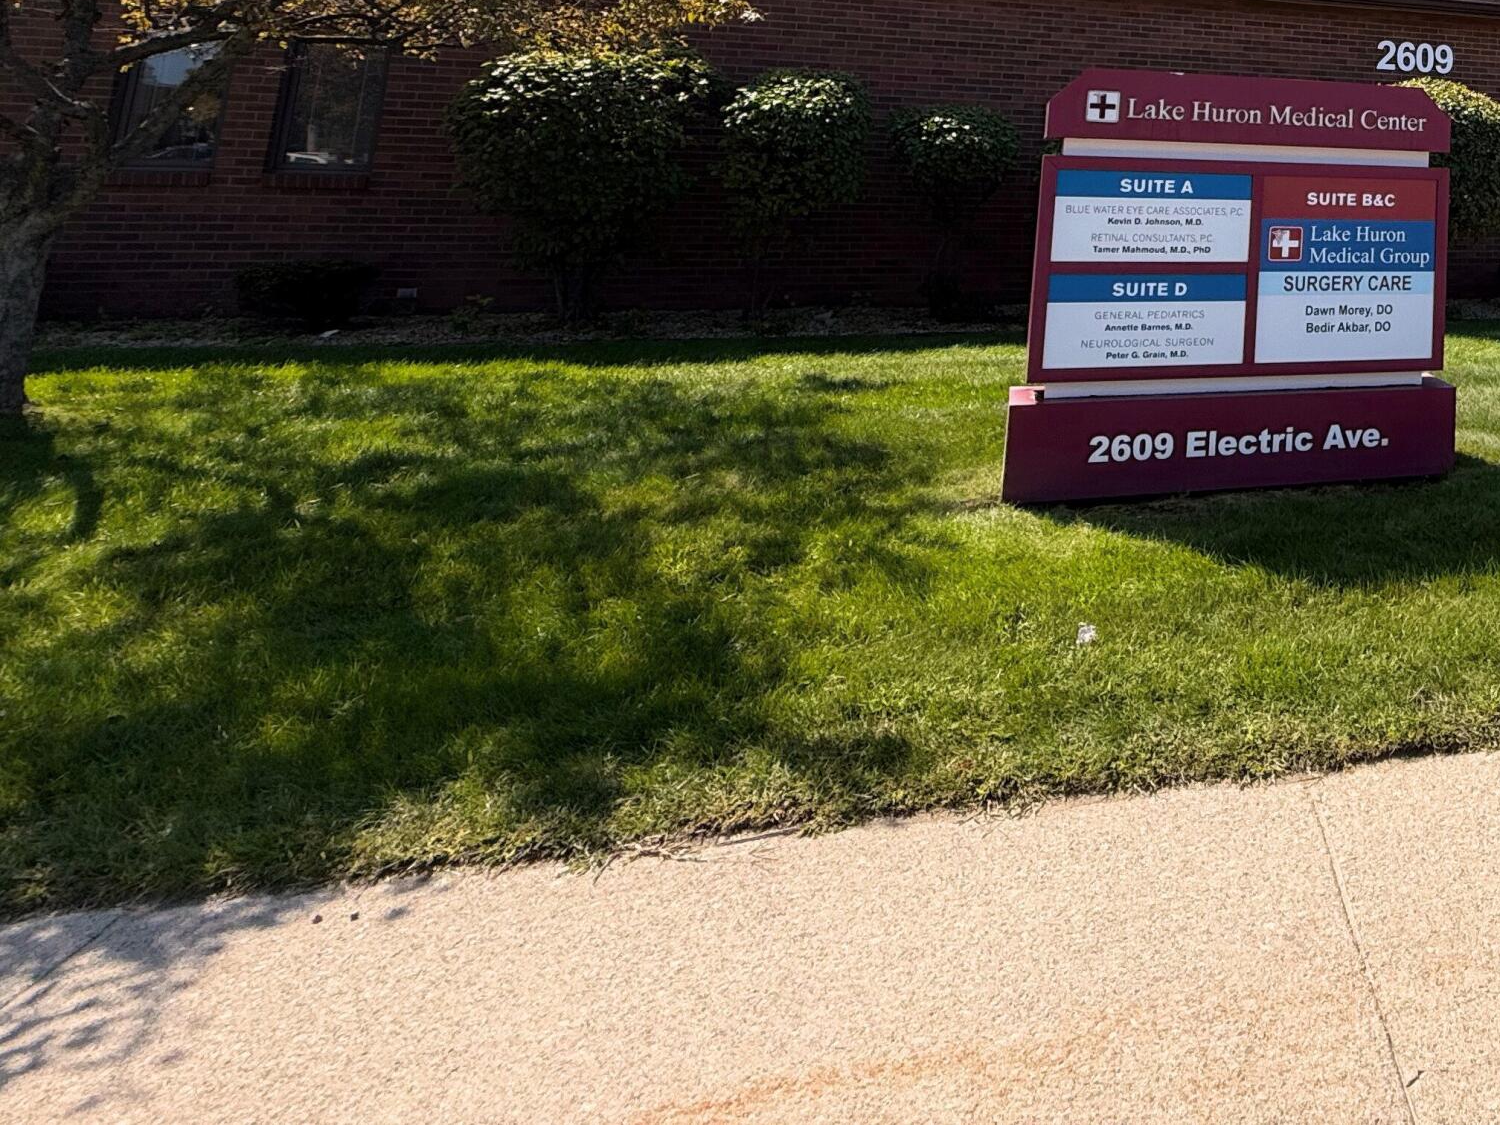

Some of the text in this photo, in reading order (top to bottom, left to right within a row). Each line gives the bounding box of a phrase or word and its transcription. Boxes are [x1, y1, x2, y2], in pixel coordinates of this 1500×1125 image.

[1376, 41, 1453, 73] 2609
[1128, 98, 1426, 132] Lake Huron Medical Center
[1120, 179, 1193, 194] SUITE A
[1307, 193, 1396, 206] SUITE B&C
[1065, 205, 1090, 214] BLUE
[1094, 206, 1123, 214] WATER
[1126, 206, 1143, 214] EYE
[1147, 206, 1169, 215] CARE
[1173, 207, 1227, 216] ASSOCIATES,
[1145, 218, 1182, 226] Johnson,
[1091, 234, 1129, 242] RETINAL
[1132, 234, 1197, 243] CONSULTANTS,
[1311, 226, 1406, 242] Lake Huron
[1122, 246, 1167, 254] Mahmoud,
[1170, 246, 1191, 254] M.D.,
[1193, 246, 1211, 254] PhD
[1309, 248, 1430, 267] Medical Group
[1112, 283, 1187, 296] SUITE D
[1283, 276, 1411, 292] SURGERY CARE
[1095, 310, 1205, 320] GENERAL PEDIATRICS
[1305, 305, 1392, 317] Dawn Morey, DO
[1306, 322, 1391, 333] Bedir Akbar, DO
[1081, 338, 1214, 348] NEUROLOGICAL SURGEON
[1143, 351, 1167, 359] Grain,
[1088, 424, 1388, 463] 2609 Electric Ave.
